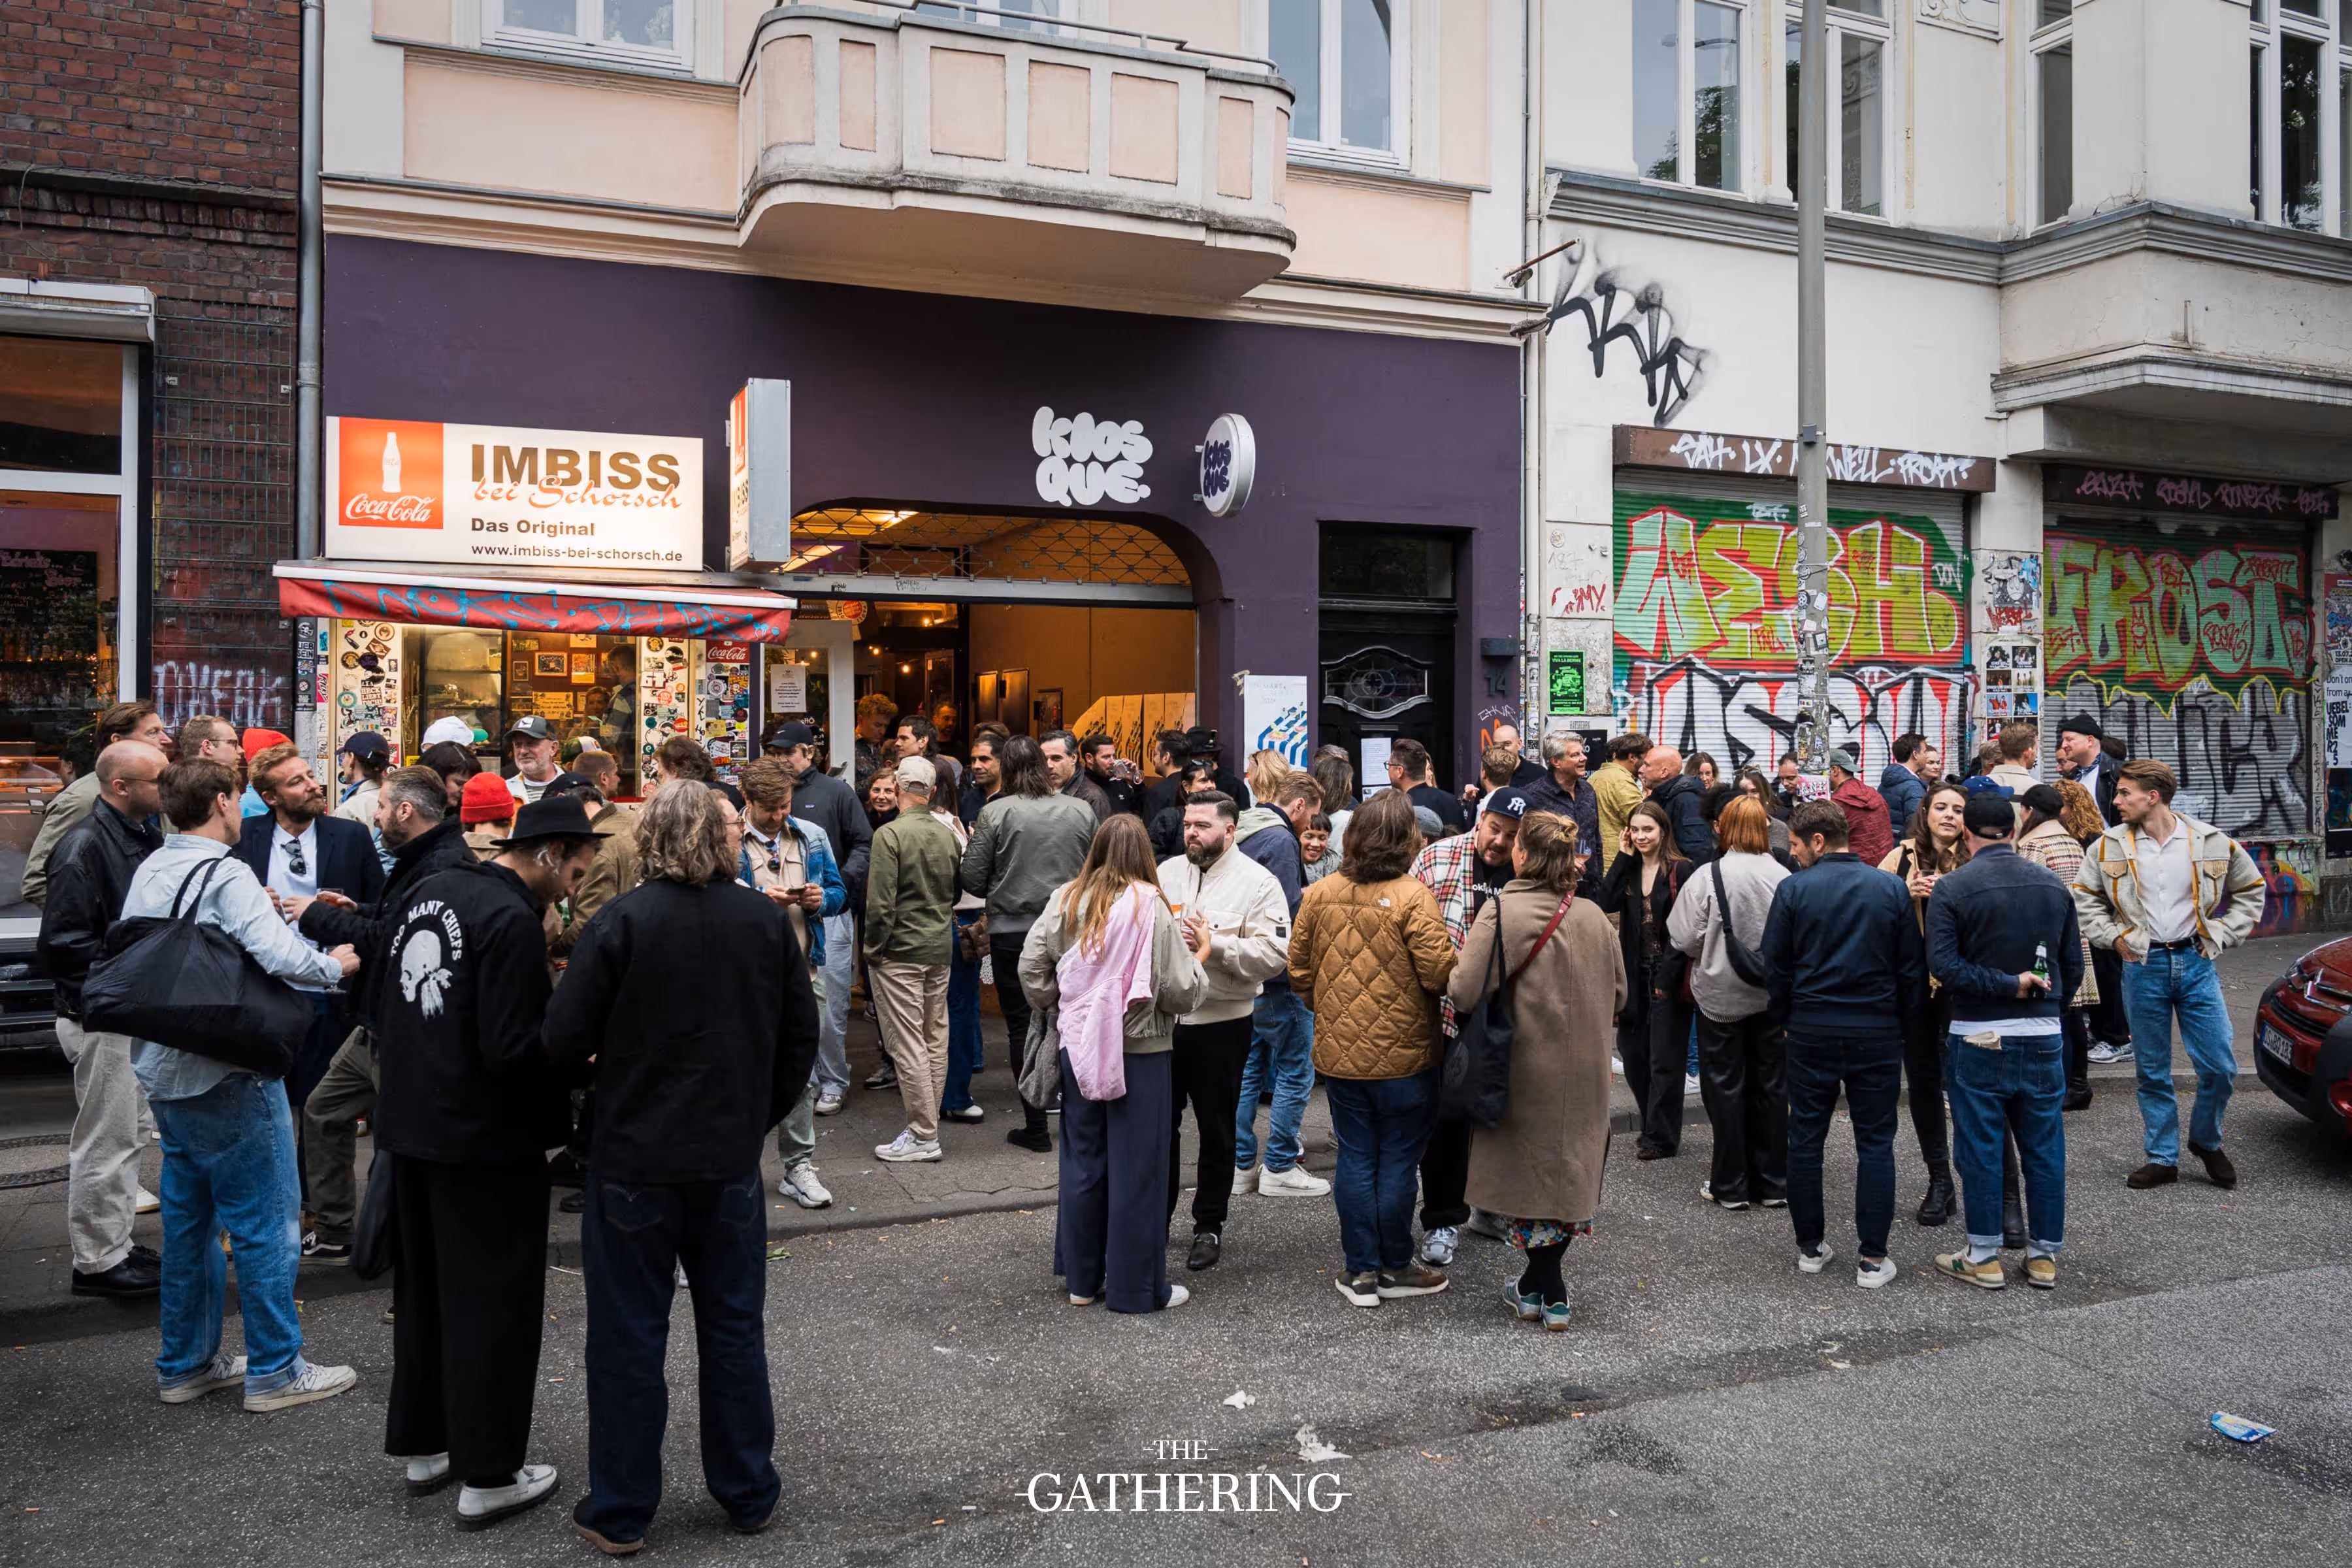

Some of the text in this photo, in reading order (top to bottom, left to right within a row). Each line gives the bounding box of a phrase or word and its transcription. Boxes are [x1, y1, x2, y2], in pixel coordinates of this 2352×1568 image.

[471, 444, 680, 492] IMBISS
[474, 475, 683, 509] bei Schorsch
[345, 493, 436, 523] Coca-Cola
[471, 517, 595, 538] Das Original
[471, 544, 683, 563] www.imbiss-bei-schorsch.de
[708, 645, 748, 661] Coca-Cola
[2327, 687, 2342, 696] from
[2328, 715, 2345, 728] SOM
[2327, 727, 2338, 740] ME
[2327, 740, 2338, 753] R2
[391, 900, 463, 961] TOO MANY CHIEFS
